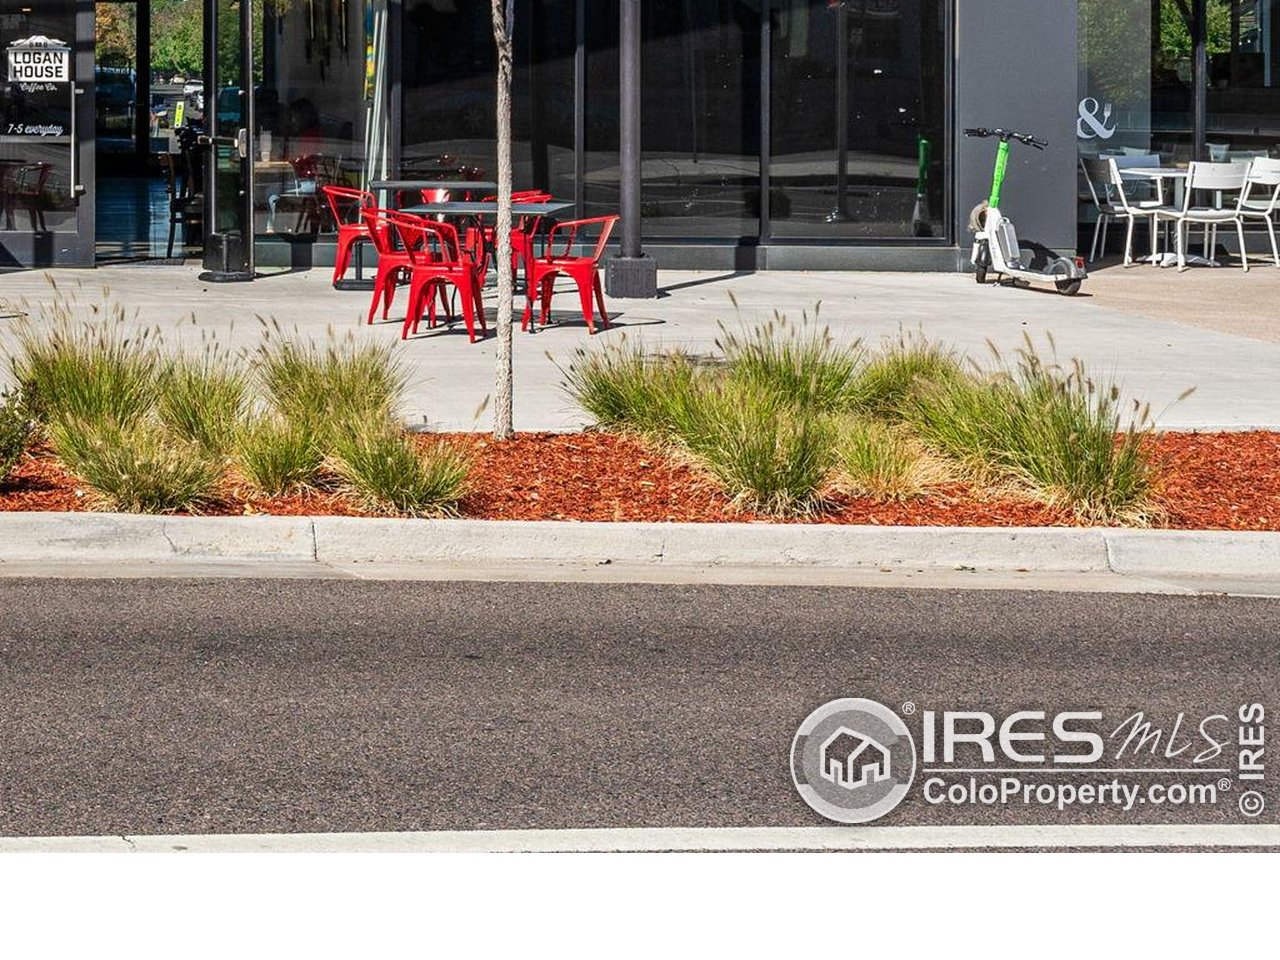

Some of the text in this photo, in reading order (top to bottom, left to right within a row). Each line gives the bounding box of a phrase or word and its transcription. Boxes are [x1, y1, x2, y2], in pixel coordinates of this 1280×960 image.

[14, 52, 63, 64] LOGAN
[14, 65, 63, 78] HOUSE
[19, 82, 45, 93] Coffee
[7, 124, 64, 137] 7-5 everyday
